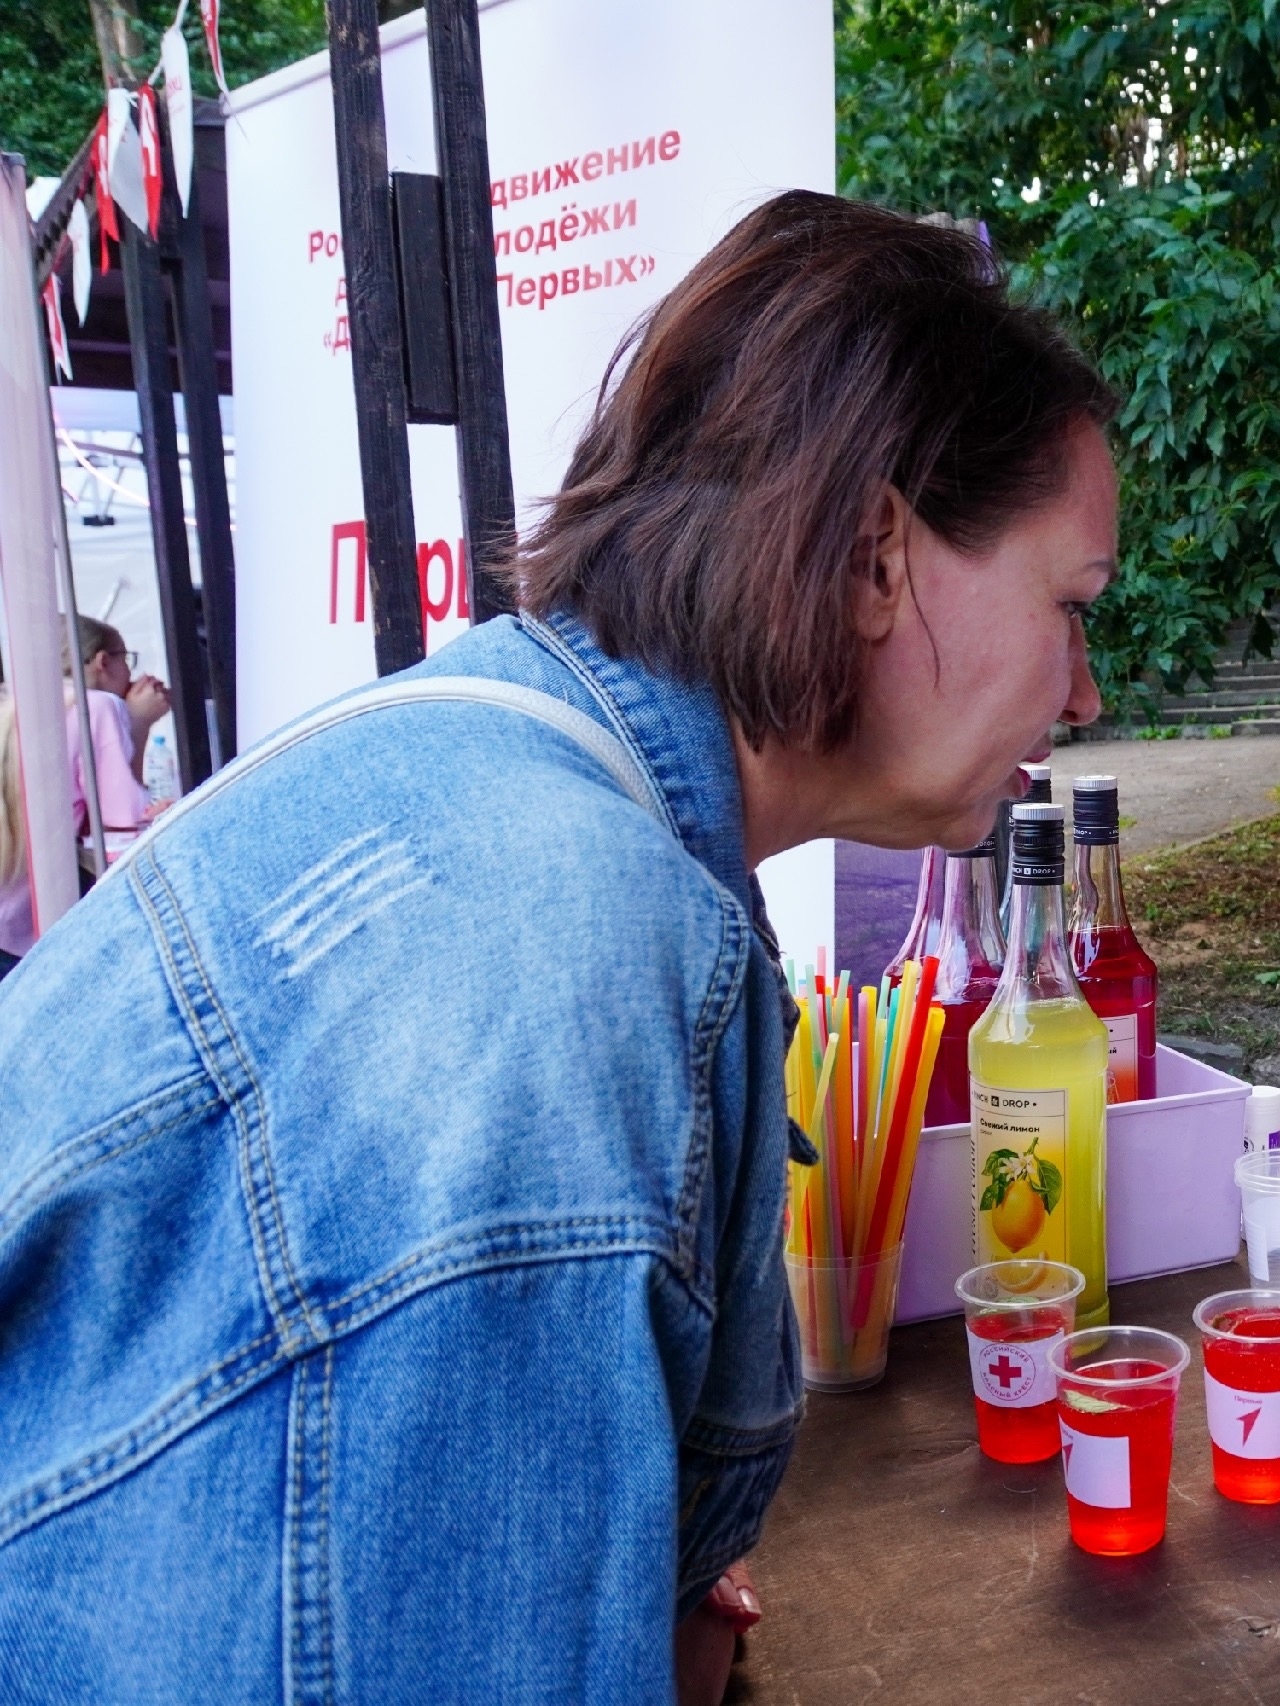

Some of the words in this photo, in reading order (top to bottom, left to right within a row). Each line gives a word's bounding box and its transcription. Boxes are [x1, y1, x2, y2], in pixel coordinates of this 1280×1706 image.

[491, 129, 681, 211] движение
[1002, 1099, 1030, 1109] DROP
[980, 1118, 1009, 1131] Свежий
[1010, 1124, 1040, 1133] лимон
